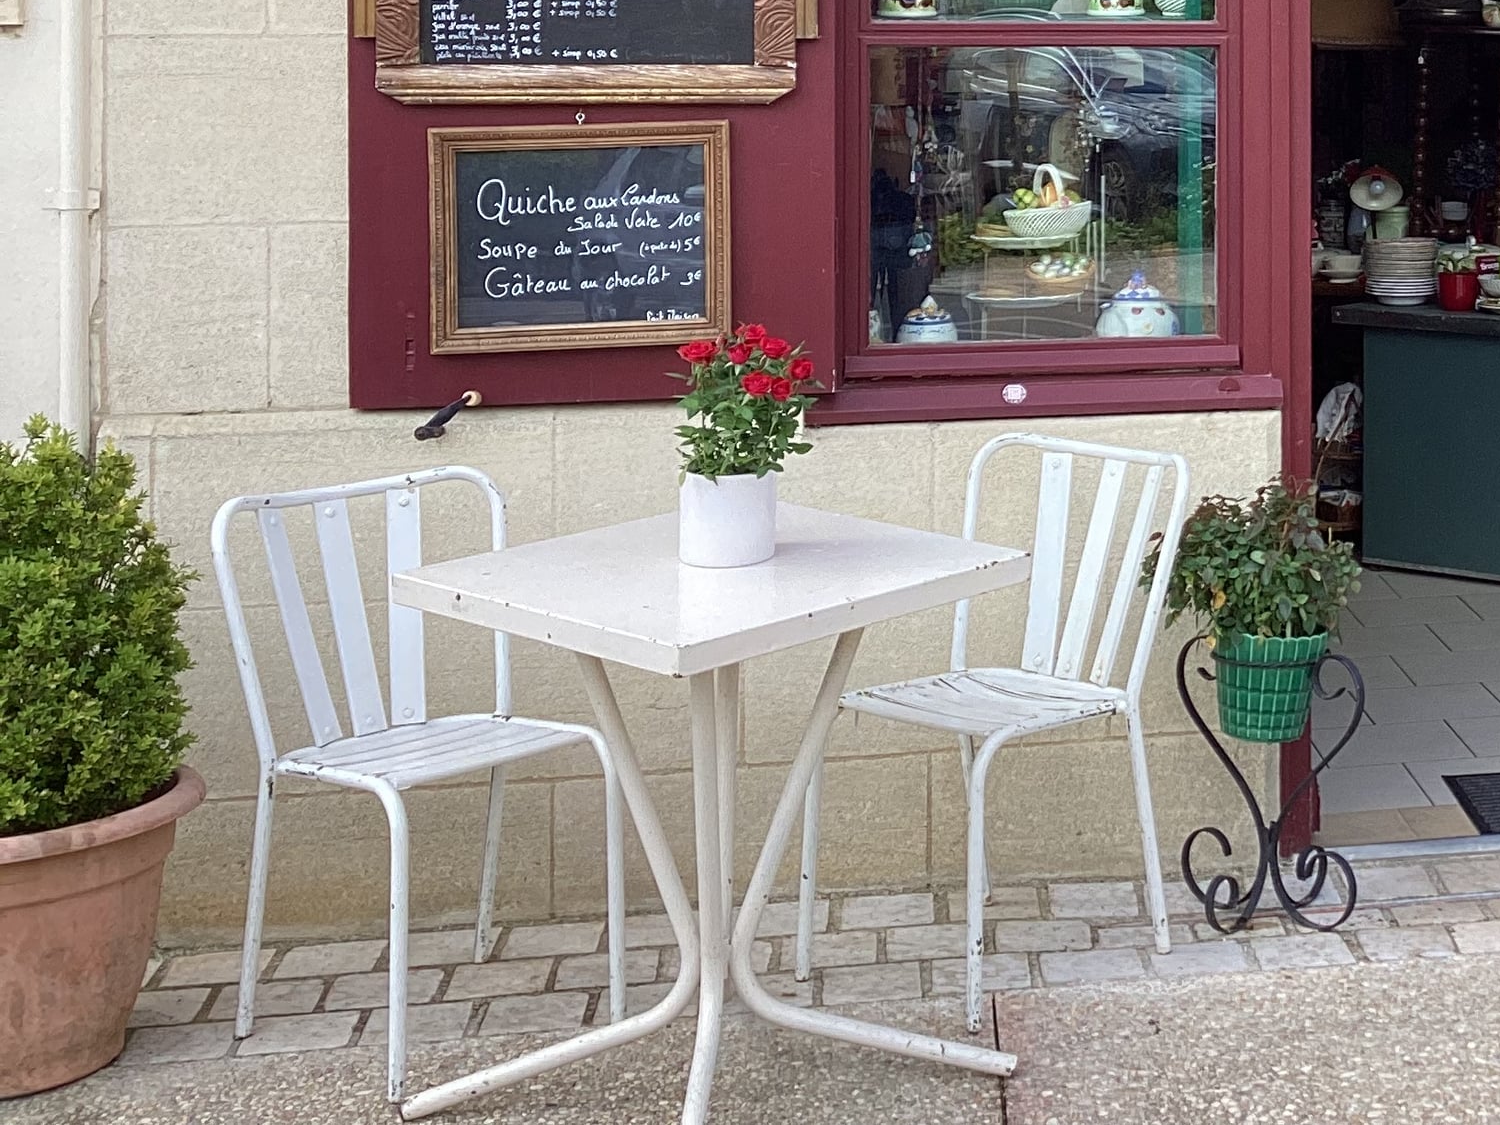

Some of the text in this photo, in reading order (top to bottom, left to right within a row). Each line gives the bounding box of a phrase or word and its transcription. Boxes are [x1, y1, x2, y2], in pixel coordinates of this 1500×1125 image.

[476, 178, 577, 226] Quiche
[583, 196, 618, 211] aux
[477, 238, 538, 260] Soupe
[555, 239, 572, 256] du
[578, 238, 622, 256] Jour
[485, 266, 571, 299] Gâteau
[580, 280, 598, 291] au
